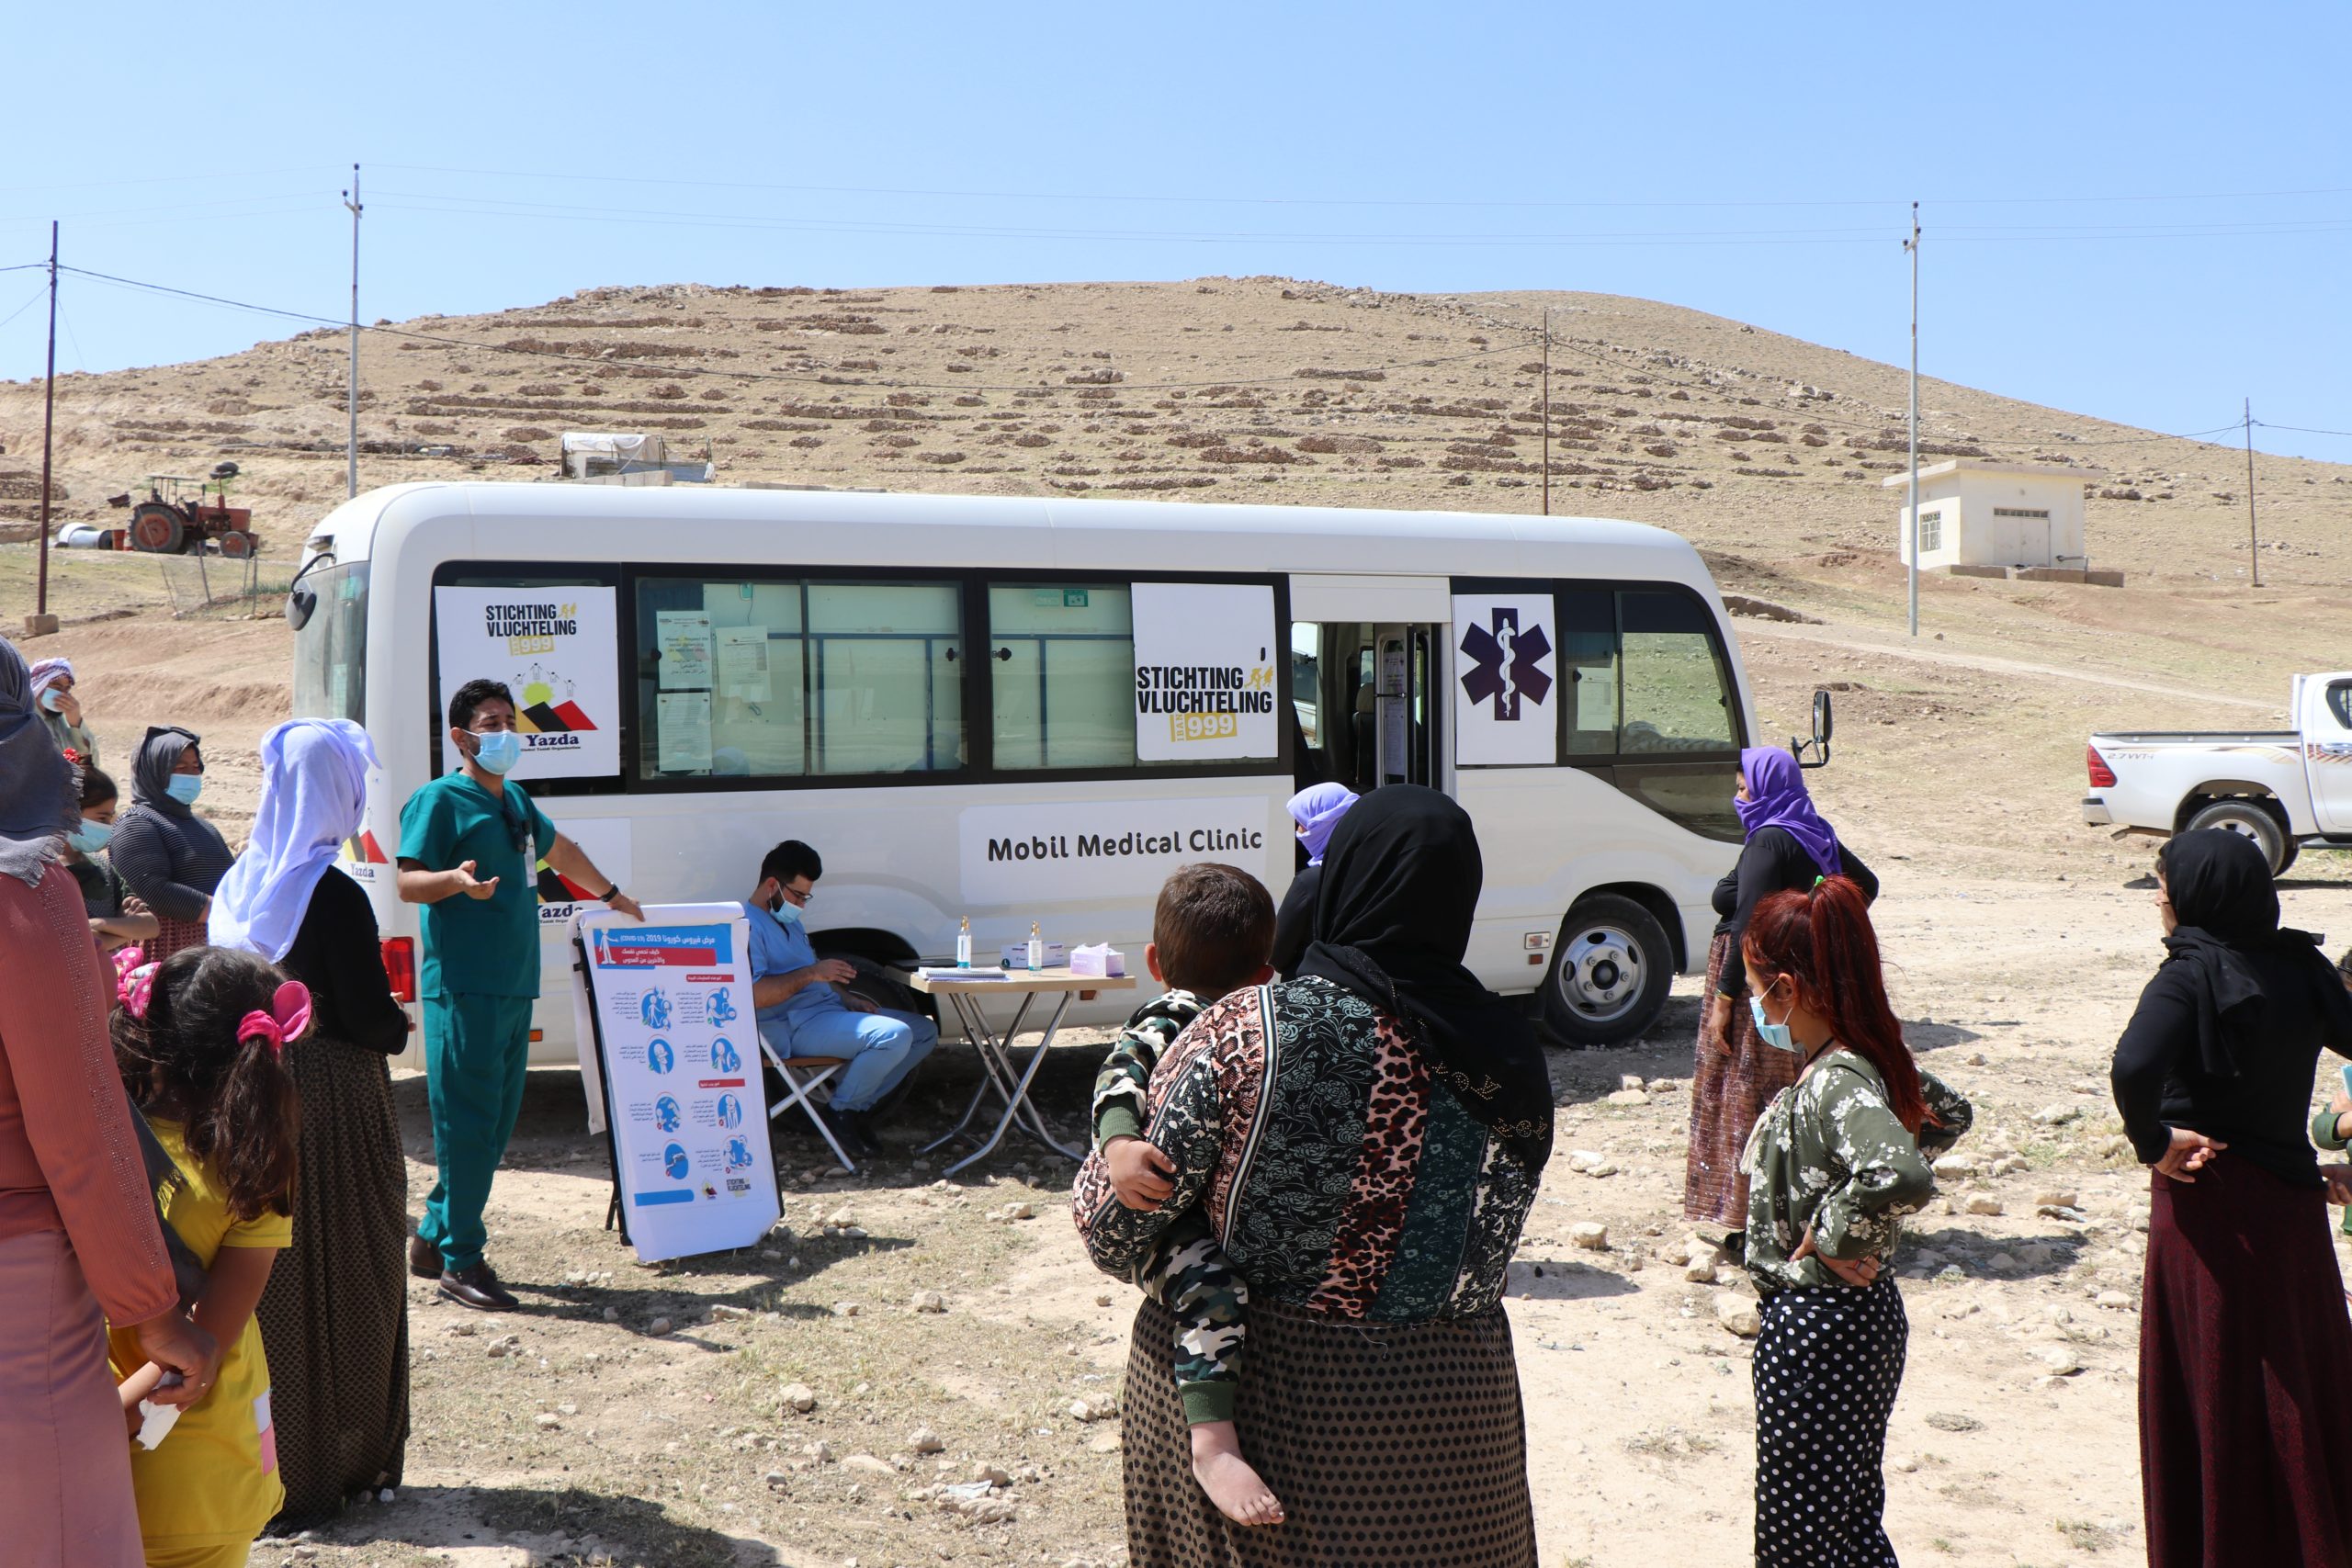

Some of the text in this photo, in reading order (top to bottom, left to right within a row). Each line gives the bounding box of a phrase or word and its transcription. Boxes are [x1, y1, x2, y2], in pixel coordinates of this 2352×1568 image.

[486, 604, 557, 620] STICHTING
[487, 620, 577, 637] VLUCHTELING
[520, 637, 552, 653] 999
[1137, 666, 1243, 689] STICHTING
[1137, 691, 1272, 713] VLUCHTELING
[1187, 714, 1234, 737] 999
[526, 734, 579, 747] Yazda
[988, 828, 1262, 862] Mobil Medical Clinic
[646, 934, 662, 942] 2019
